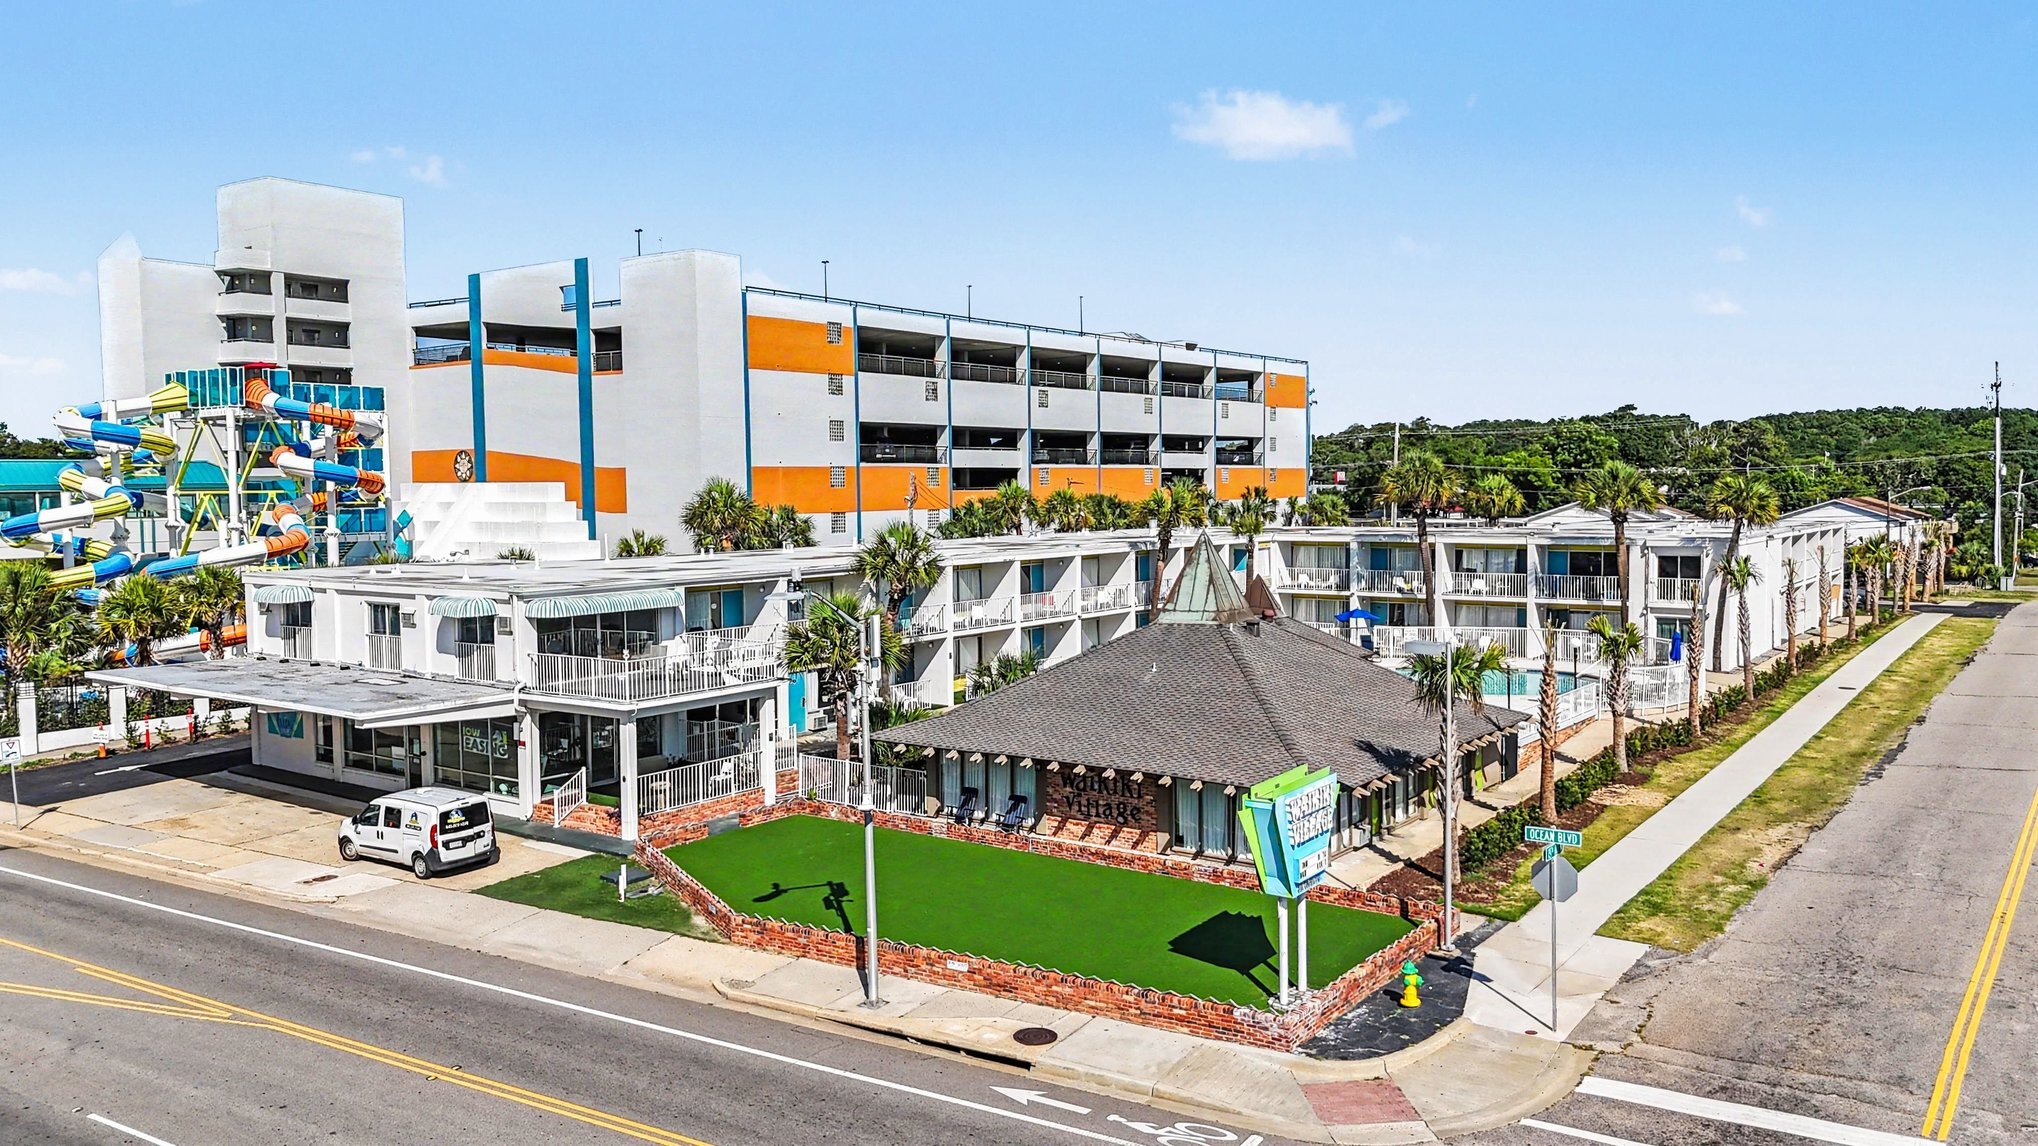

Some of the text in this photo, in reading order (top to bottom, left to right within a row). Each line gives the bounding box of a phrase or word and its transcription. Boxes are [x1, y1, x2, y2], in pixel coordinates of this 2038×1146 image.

[1062, 793, 1142, 824] Village
[1285, 783, 1333, 822] WAIKIKI
[1288, 808, 1333, 848] VILLAGE
[1529, 828, 1578, 844] OCEAN BLVD
